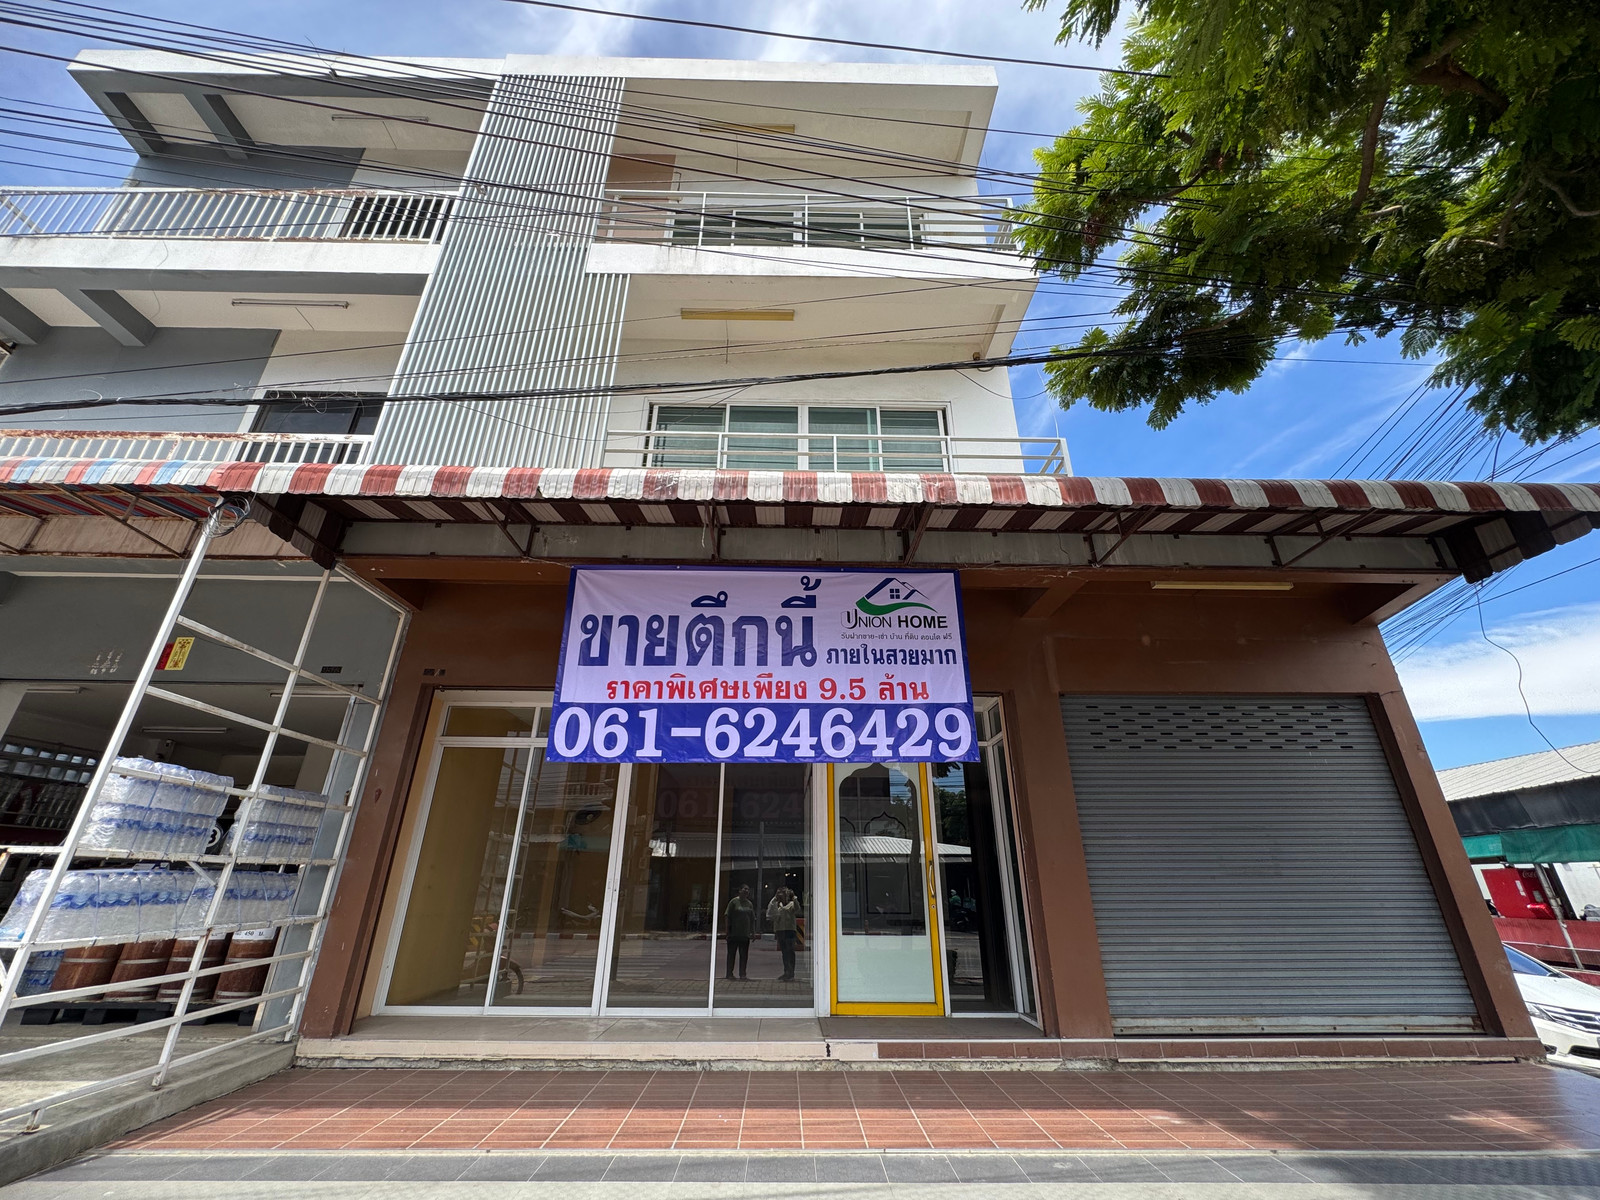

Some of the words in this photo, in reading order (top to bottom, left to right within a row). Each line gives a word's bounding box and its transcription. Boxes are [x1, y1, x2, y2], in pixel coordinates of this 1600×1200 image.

[577, 576, 821, 667] ขายตึกนี้
[840, 609, 892, 629] UNION
[898, 615, 948, 629] HOME
[890, 632, 903, 640] บ้าน
[826, 643, 958, 665] ภายในสวยมาก
[606, 673, 808, 700] ราคาพิเศษเพียง
[819, 677, 867, 700] 9.5
[879, 673, 930, 700] ล้าน
[553, 706, 972, 758] 061-6246429
